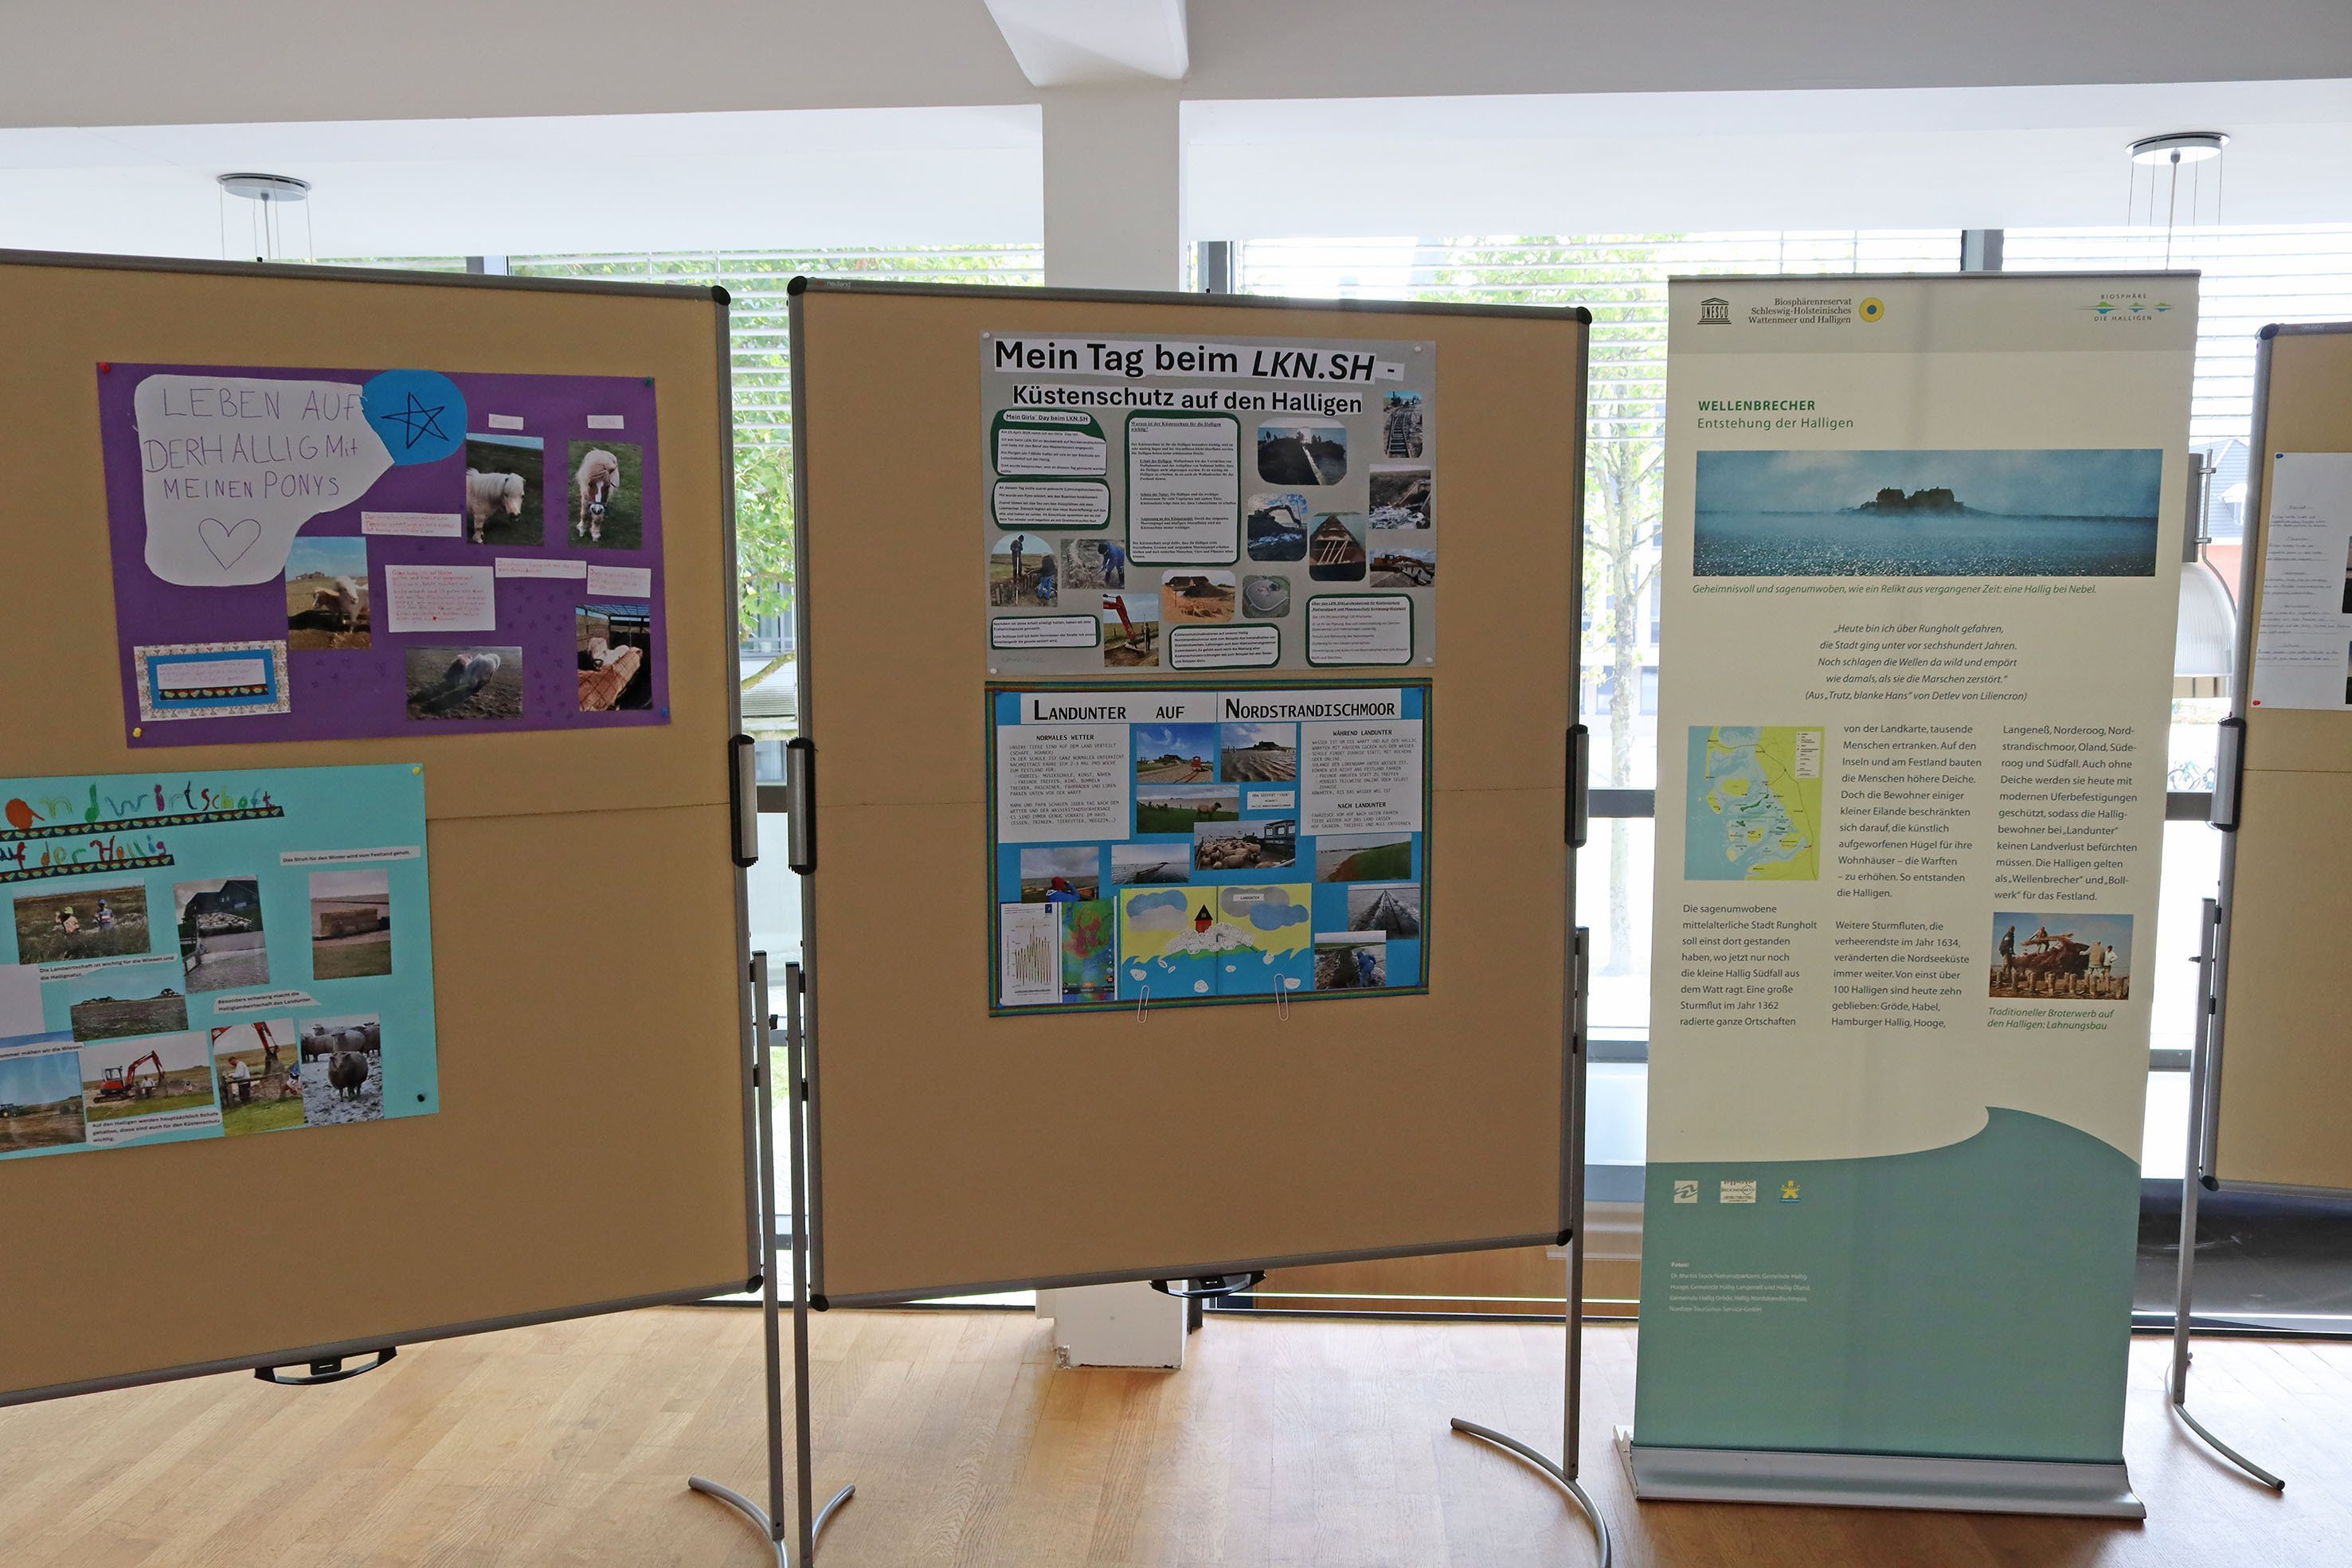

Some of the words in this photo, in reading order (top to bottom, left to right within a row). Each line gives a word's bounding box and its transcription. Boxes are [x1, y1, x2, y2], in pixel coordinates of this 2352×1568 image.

[2100, 291, 2147, 300] BIOSPHÄRE
[1775, 297, 1852, 307] Biosphärenreservat
[1700, 306, 1728, 319] UNESCO
[1751, 306, 1852, 317] Schleswig-Holsteinisches
[1748, 315, 1798, 324] Wattenmeer
[1799, 315, 1816, 324] und
[1818, 315, 1851, 327] Halligen
[995, 340, 1078, 371] Mein
[1086, 342, 1144, 378] Tag
[1155, 344, 1239, 373] beim
[1251, 350, 1376, 381] LKN.SH
[163, 388, 280, 420] LEBEN
[302, 390, 361, 421] AUF
[1012, 385, 1175, 408] Küstenschutz
[1181, 389, 1219, 409] auf
[1223, 390, 1266, 409] den
[1272, 391, 1363, 414] Halligen
[1698, 399, 1815, 412] WELLENBRECHER
[1697, 416, 1771, 432] Entstehung
[1775, 416, 1797, 428] der
[1801, 416, 1853, 432] Halligen
[163, 478, 253, 500] MEINEN
[264, 471, 339, 499] PONYS
[1692, 583, 1755, 594] Geheimnisvoll
[1756, 584, 1775, 594] und
[1775, 584, 1847, 596] sagenumwoben,
[1848, 584, 1865, 593] wie
[1865, 584, 1880, 593] ein
[1880, 583, 1906, 594] Relikt
[1906, 585, 1923, 594] aus
[1924, 585, 1982, 596] vergangener
[1982, 583, 2002, 594] Zeit:
[2003, 584, 2023, 594] eine
[2024, 584, 2052, 596] Hallig
[2053, 584, 2068, 594] bei
[2068, 584, 2097, 594] Nebel.
[1865, 623, 1880, 633] bin
[1881, 623, 1896, 633] ich
[1896, 623, 1918, 634] über
[1918, 623, 1960, 635] Rungholt
[1961, 623, 2004, 635] gefahren,
[1819, 640, 1833, 651] die
[1834, 640, 1859, 651] Stadt
[1859, 640, 1880, 652] ging
[1881, 641, 1906, 651] unter
[1907, 642, 1922, 651] vor
[1923, 639, 1983, 651] sechshundert
[1983, 639, 2017, 651] Jahren.
[1818, 656, 1841, 667] Noch
[1842, 656, 1882, 669] schlagen
[1883, 656, 1898, 667] die
[1899, 656, 1929, 667] Wellen
[1930, 656, 1943, 667] da
[1943, 656, 1963, 667] wild
[1963, 658, 1983, 668] und
[1983, 658, 2017, 670] empört
[1826, 673, 1841, 683] wie
[1842, 673, 1877, 685] damals,
[1878, 673, 1892, 684] als
[1892, 674, 1905, 684] sie
[1906, 673, 1920, 684] die
[1921, 674, 1965, 684] Marschen
[1853, 690, 1884, 700] blanke
[1913, 692, 1931, 701] von
[1931, 690, 1961, 701] Detlev
[1962, 693, 1979, 702] von
[1980, 690, 2028, 702] Liliencron)
[1155, 705, 1185, 720] AUF
[1333, 729, 1358, 737] WÄHREND
[1862, 723, 1879, 734] der
[1880, 723, 1929, 735] Landkarte,
[1930, 724, 1974, 734] tausende
[1842, 740, 1890, 750] Menschen
[1892, 740, 1939, 750] ertranken.
[1940, 741, 1958, 751] Auf
[1958, 741, 1977, 752] den
[41, 840, 86, 866] der
[89, 834, 166, 862] Hallig
[1683, 904, 1698, 914] Die
[1700, 904, 1778, 916] sagenumwobene
[1682, 920, 1750, 930] mittelalterliche
[1751, 920, 1775, 930] Stadt
[1776, 920, 1818, 932] Rungholt
[1681, 936, 1697, 946] soll
[1699, 936, 1721, 946] einst
[1722, 936, 1742, 947] dort
[1743, 936, 1790, 948] gestanden
[1681, 952, 1712, 964] haben,
[1728, 952, 1749, 965] jetzt
[1750, 955, 1767, 964] nur
[1767, 952, 1790, 963] noch
[1681, 968, 1695, 978] die
[1696, 968, 1724, 979] kleine
[1725, 968, 1751, 980] Hallig
[1752, 968, 1783, 979] Südfall
[1784, 970, 1800, 979] aus
[1681, 984, 1701, 995] dem
[1702, 984, 1724, 995] Watt
[1725, 986, 1745, 996] ragt.
[1746, 984, 1766, 994] Eine
[1767, 983, 1794, 996] große
[1680, 999, 1722, 1011] Sturmflut
[1724, 1000, 1736, 1010] im
[1737, 1000, 1755, 1011] Jahr
[1758, 1000, 1779, 1010] 1362
[1988, 1007, 2047, 1018] Traditioneller
[2047, 1008, 2097, 1019] Broterwerb
[2098, 1008, 2115, 1019] auf
[1680, 1016, 1715, 1026] radierte
[1716, 1018, 1743, 1028] ganze
[1744, 1015, 1797, 1026] Ortschaften
[1986, 1018, 2005, 1028] den
[2006, 1019, 2045, 1031] Halligen:
[2046, 1020, 2107, 1033] Lahnungsbau
